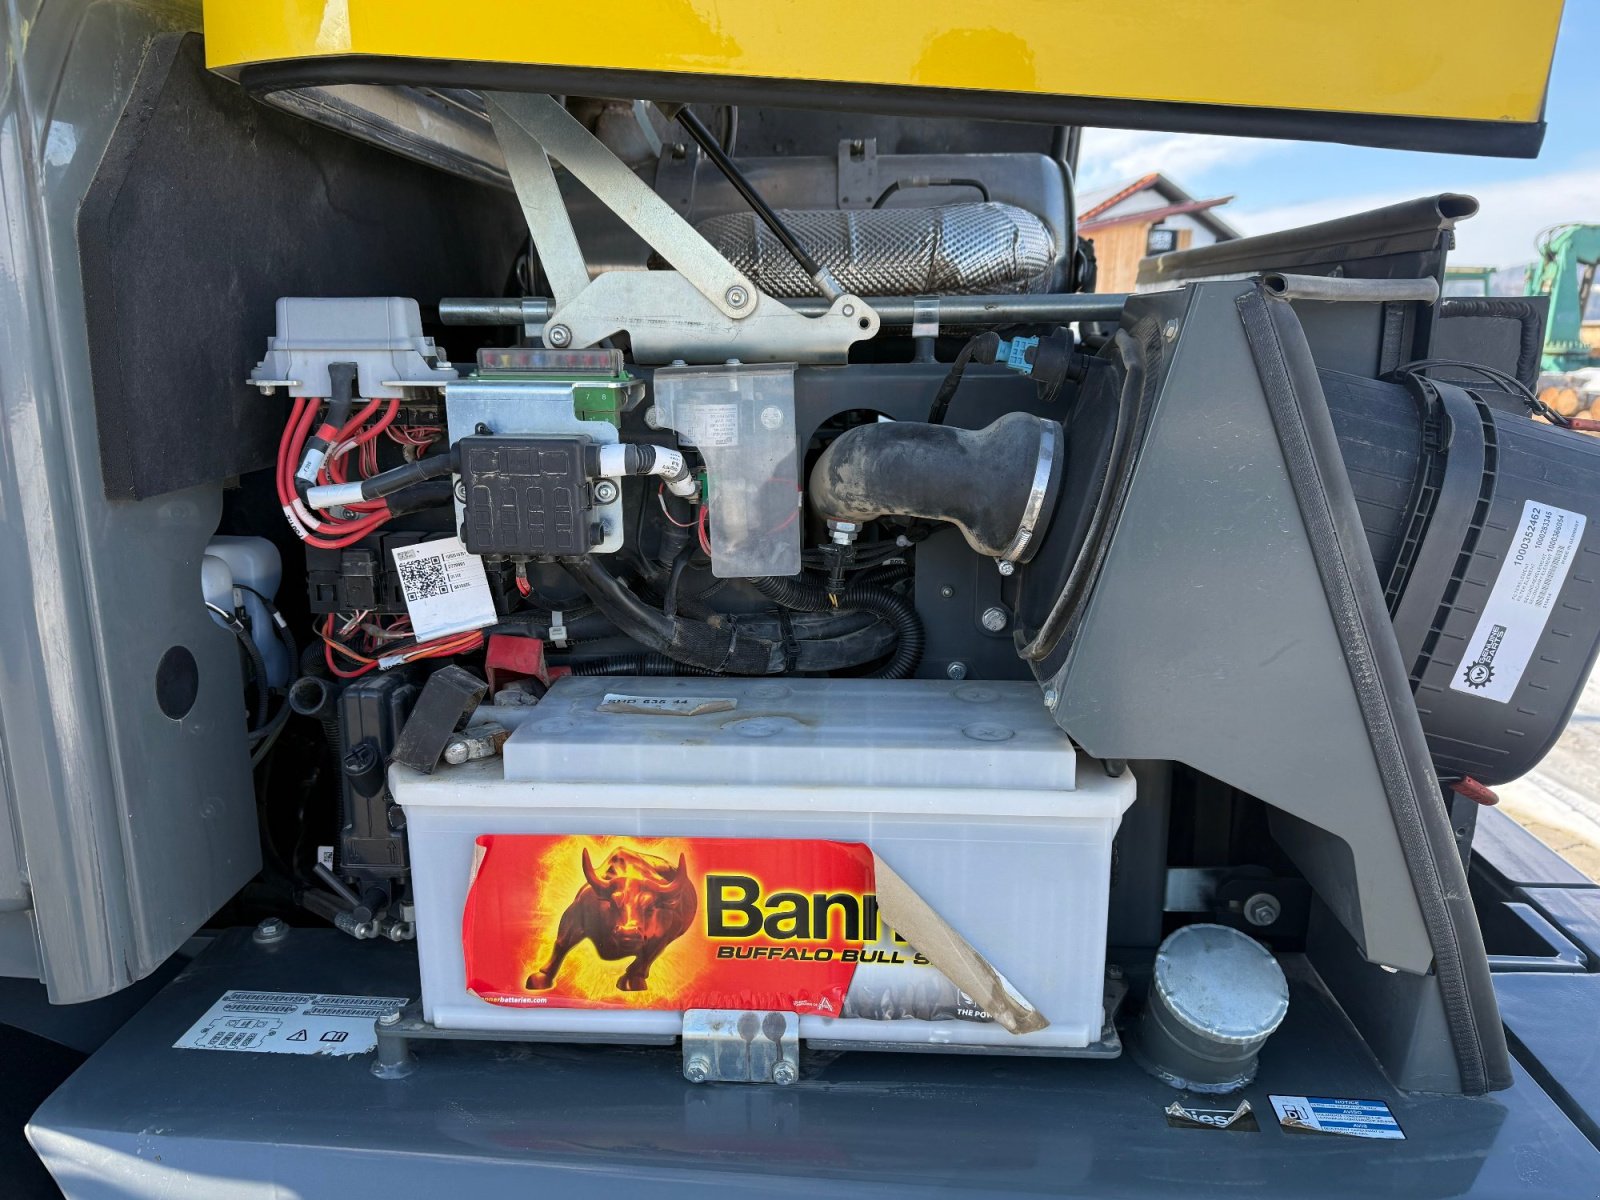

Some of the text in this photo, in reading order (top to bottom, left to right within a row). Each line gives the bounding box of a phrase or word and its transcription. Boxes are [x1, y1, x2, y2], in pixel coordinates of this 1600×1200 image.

[1513, 507, 1541, 566] 1000352462
[1479, 626, 1500, 664] GENUINE
[1485, 630, 1505, 663] PARTS
[706, 874, 906, 942] Bann
[717, 946, 933, 965] BUFFALO BULL S
[957, 1008, 993, 1019] THE POW
